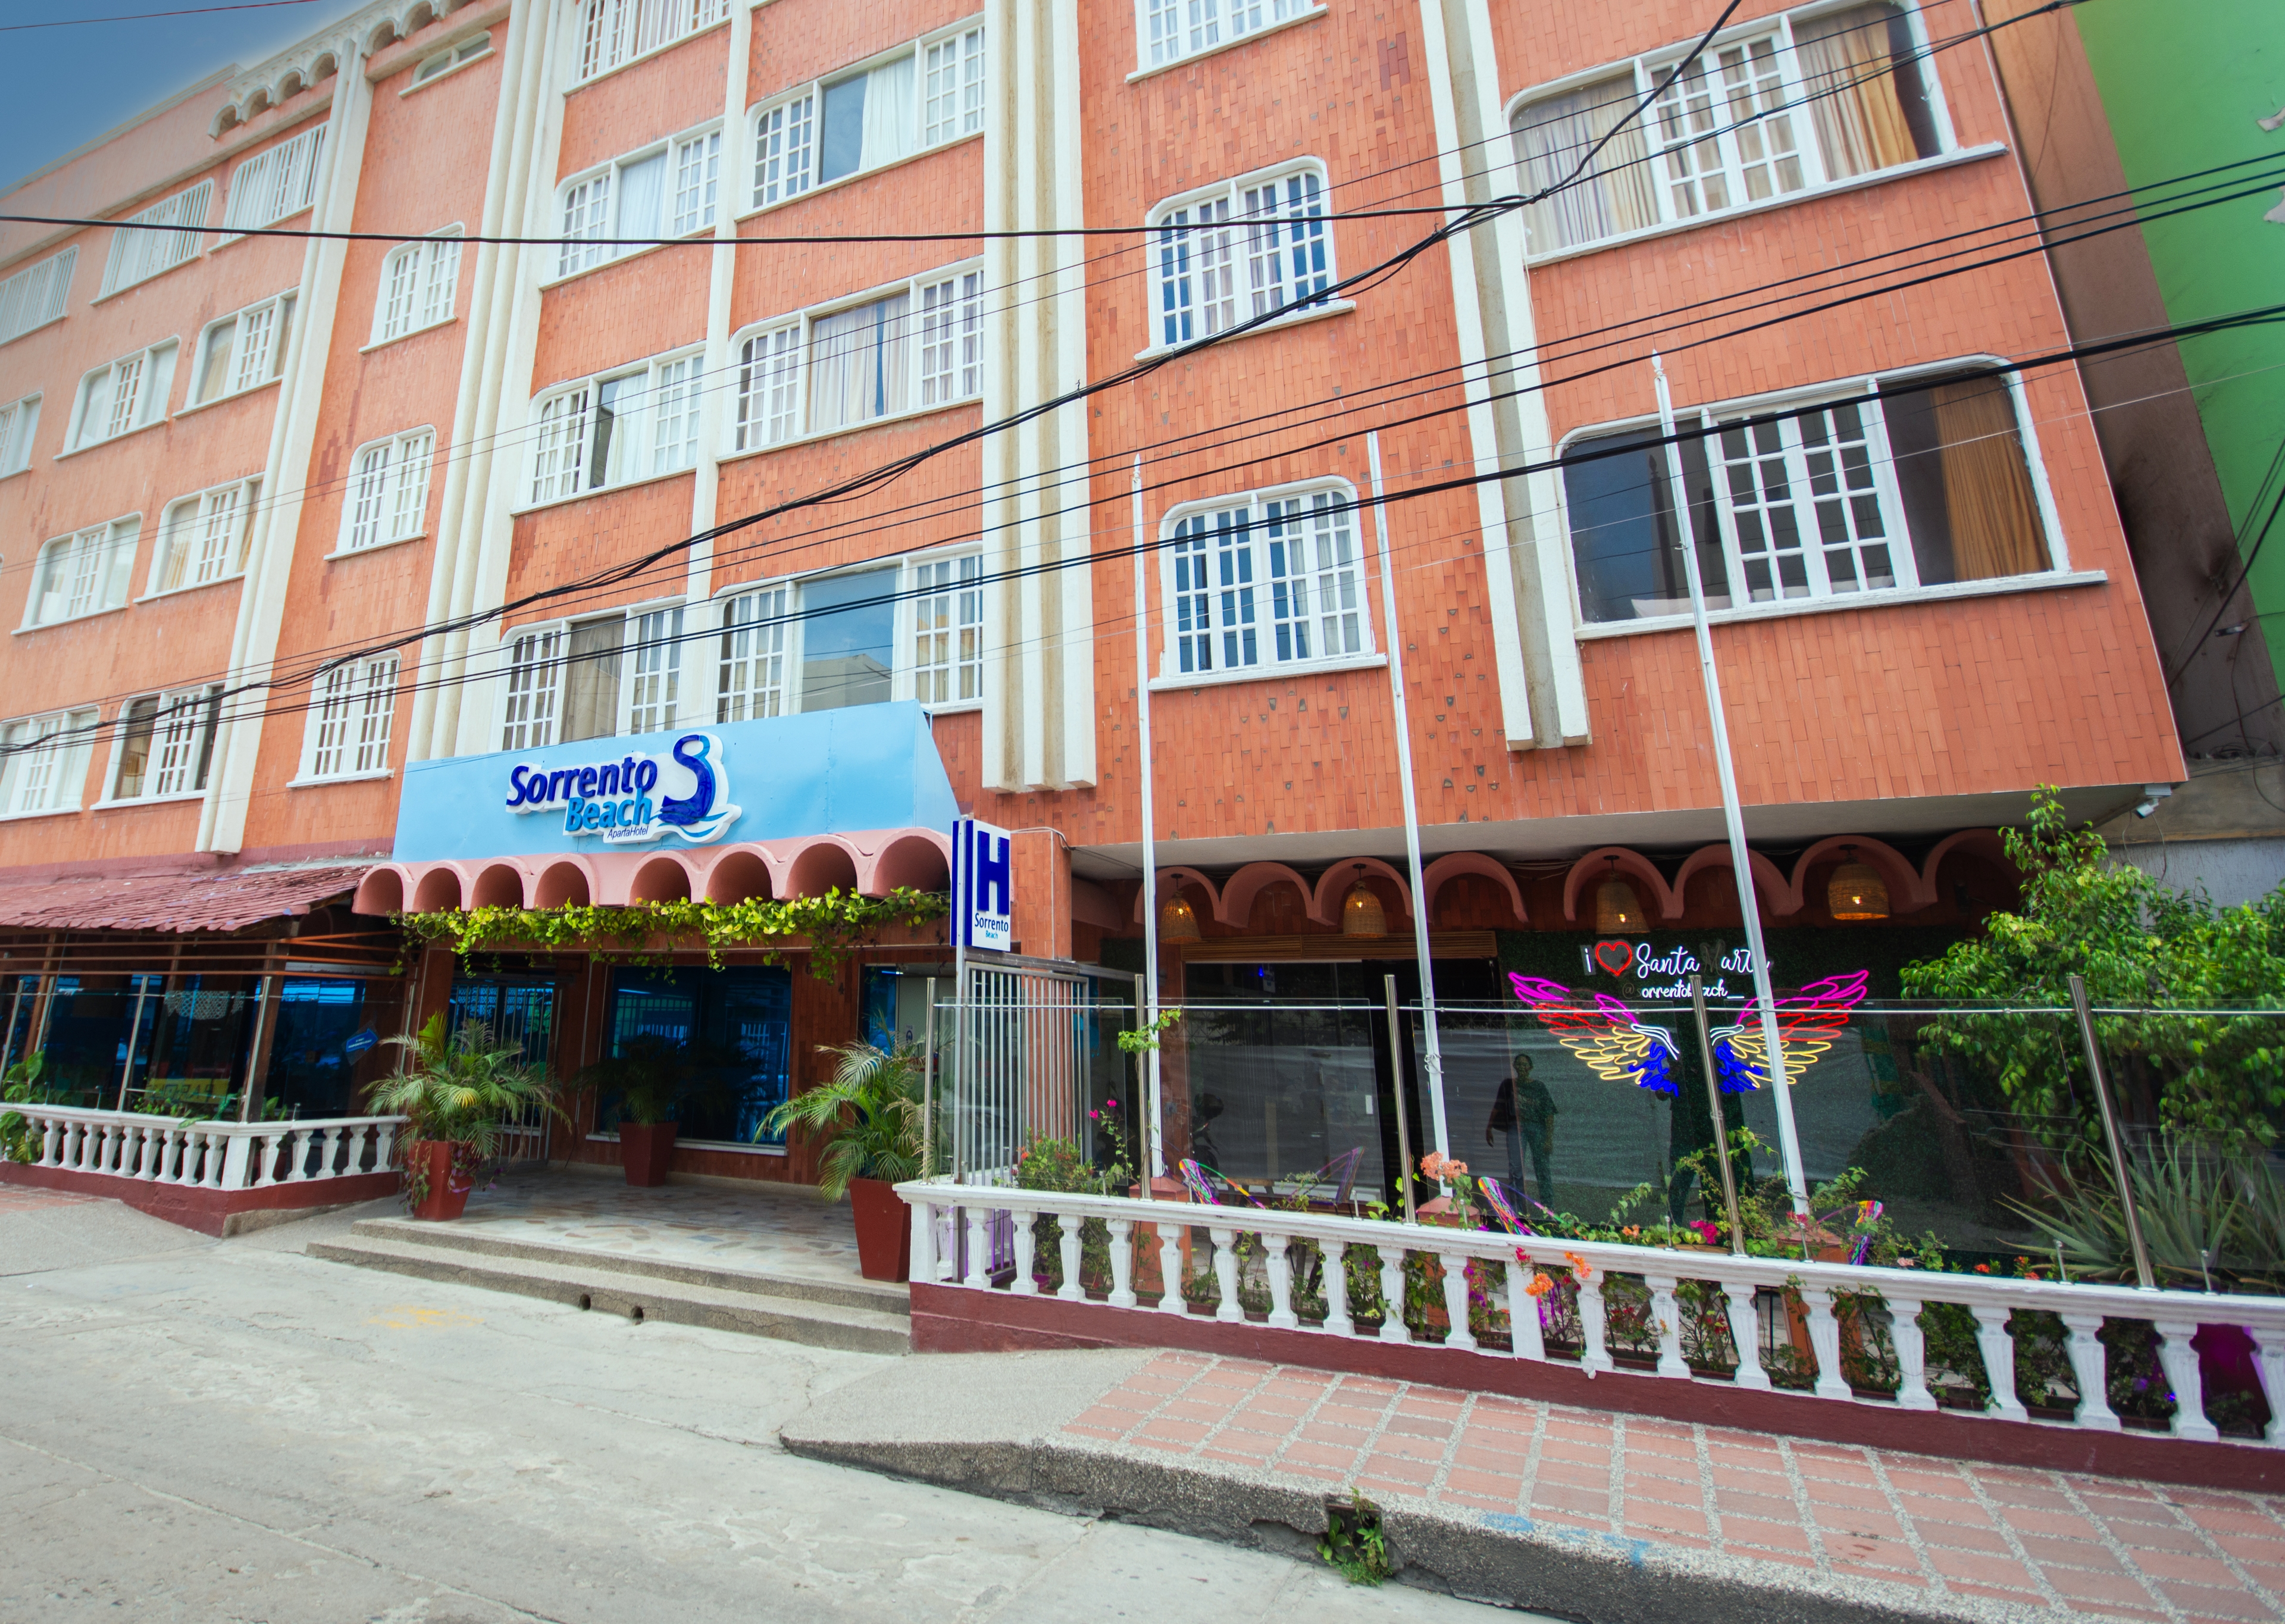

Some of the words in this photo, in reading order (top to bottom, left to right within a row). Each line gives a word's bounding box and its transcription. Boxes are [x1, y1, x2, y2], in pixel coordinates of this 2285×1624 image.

[506, 757, 658, 807] Sorrento
[565, 788, 653, 831] Beach
[607, 825, 649, 839] ApartaHotel
[976, 830, 1010, 915] H
[974, 912, 1009, 933] Sorrento
[985, 930, 998, 940] Beach
[1636, 943, 1700, 978] Santa
[1702, 945, 1771, 976] Mart
